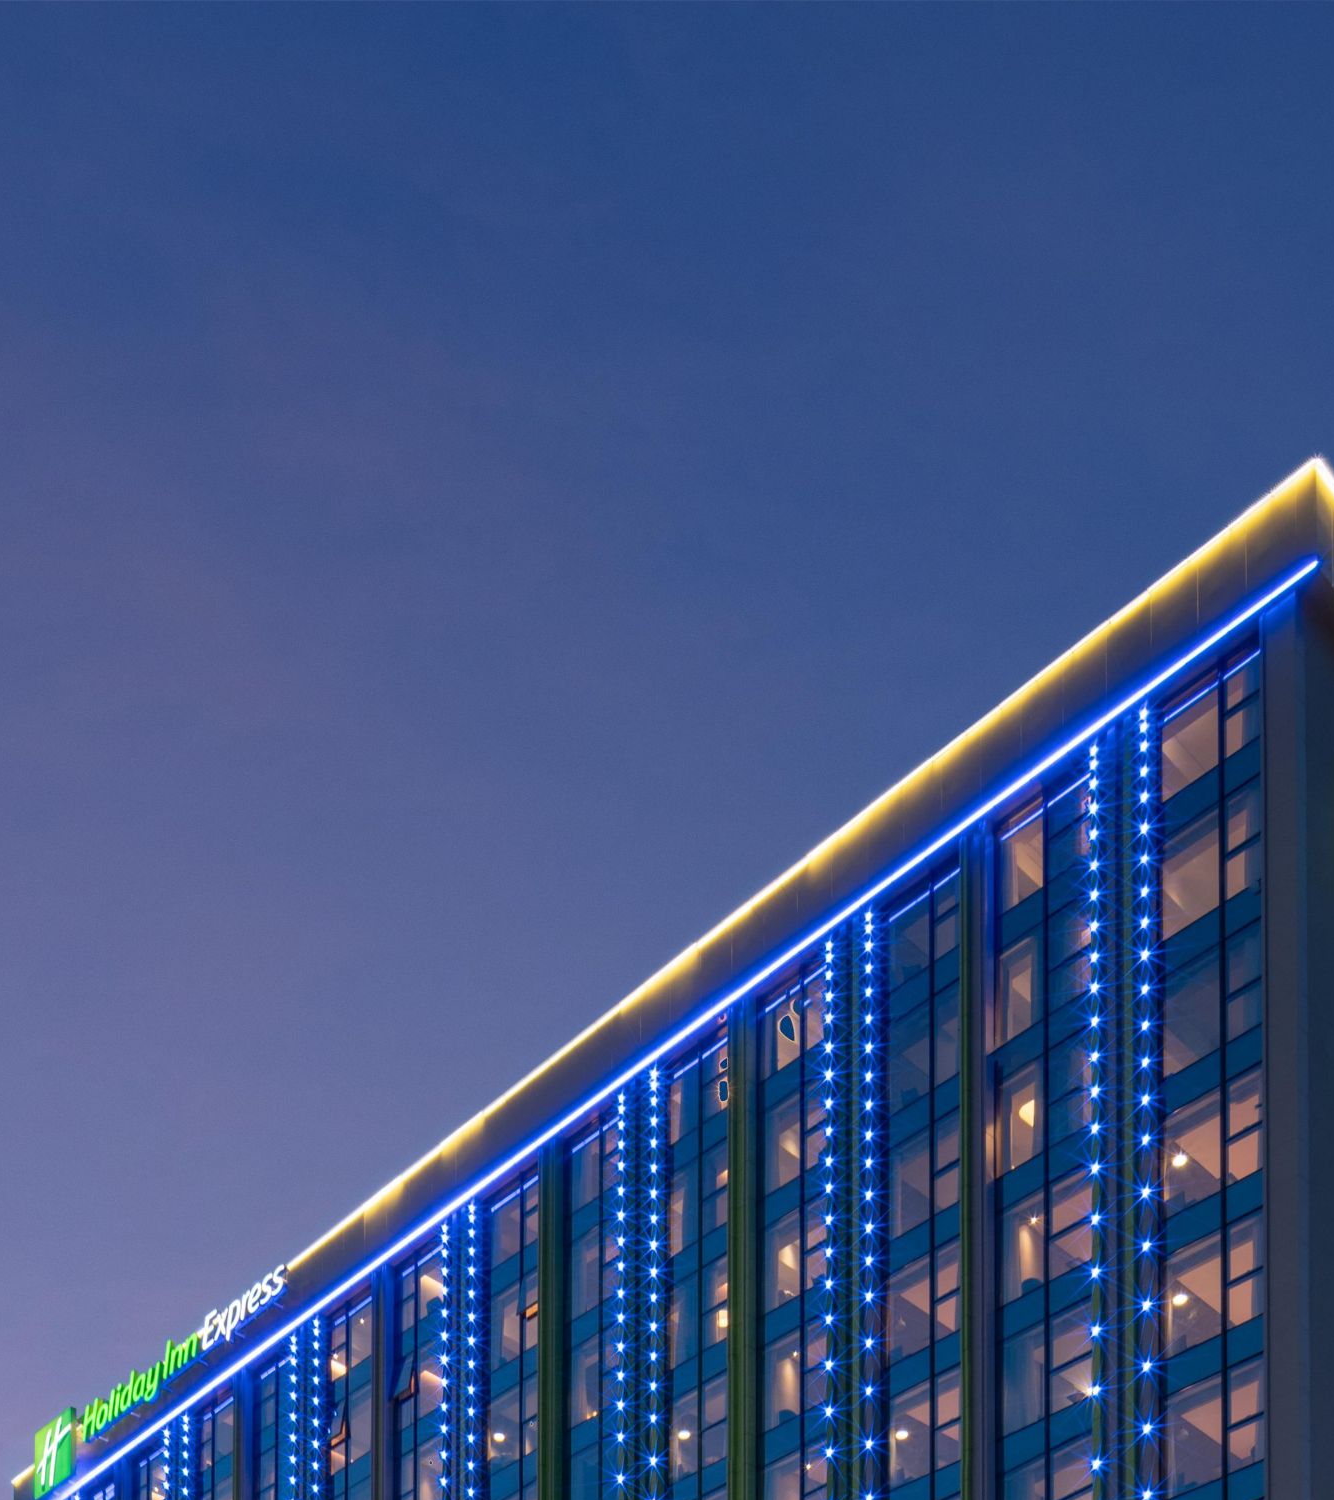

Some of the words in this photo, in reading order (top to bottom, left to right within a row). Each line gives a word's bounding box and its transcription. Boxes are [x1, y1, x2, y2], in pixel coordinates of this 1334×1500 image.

[82, 1362, 160, 1442] Holiday
[162, 1333, 199, 1379] Inn
[202, 1264, 286, 1350] Express
